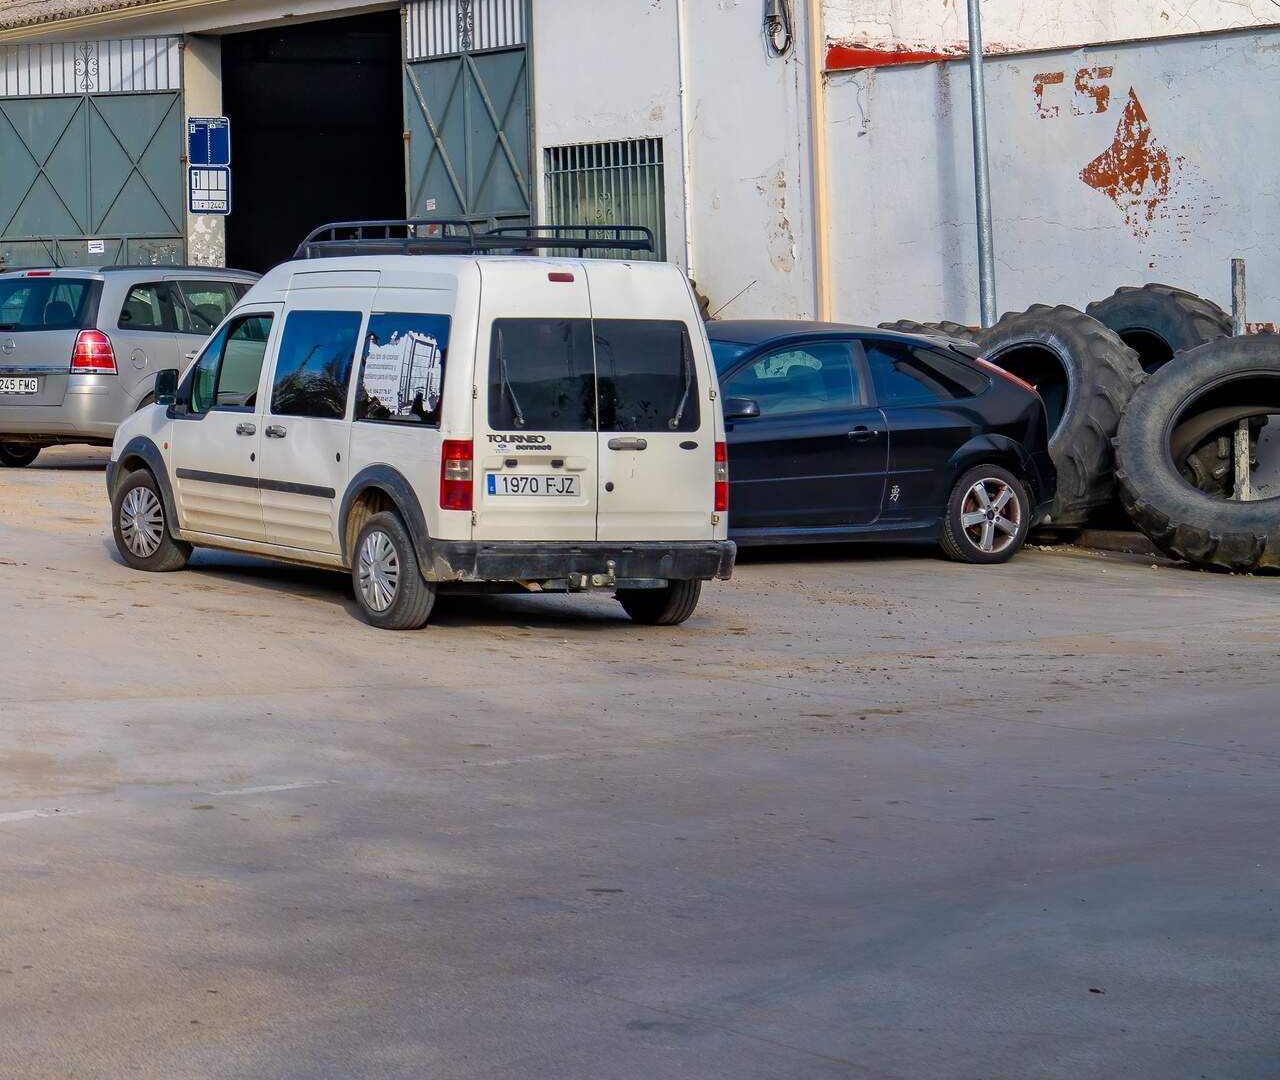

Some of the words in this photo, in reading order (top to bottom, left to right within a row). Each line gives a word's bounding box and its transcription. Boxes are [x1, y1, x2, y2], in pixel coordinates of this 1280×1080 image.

[486, 434, 546, 444] TOURNEO
[502, 476, 539, 493] 1970
[545, 477, 575, 494] FJZ
